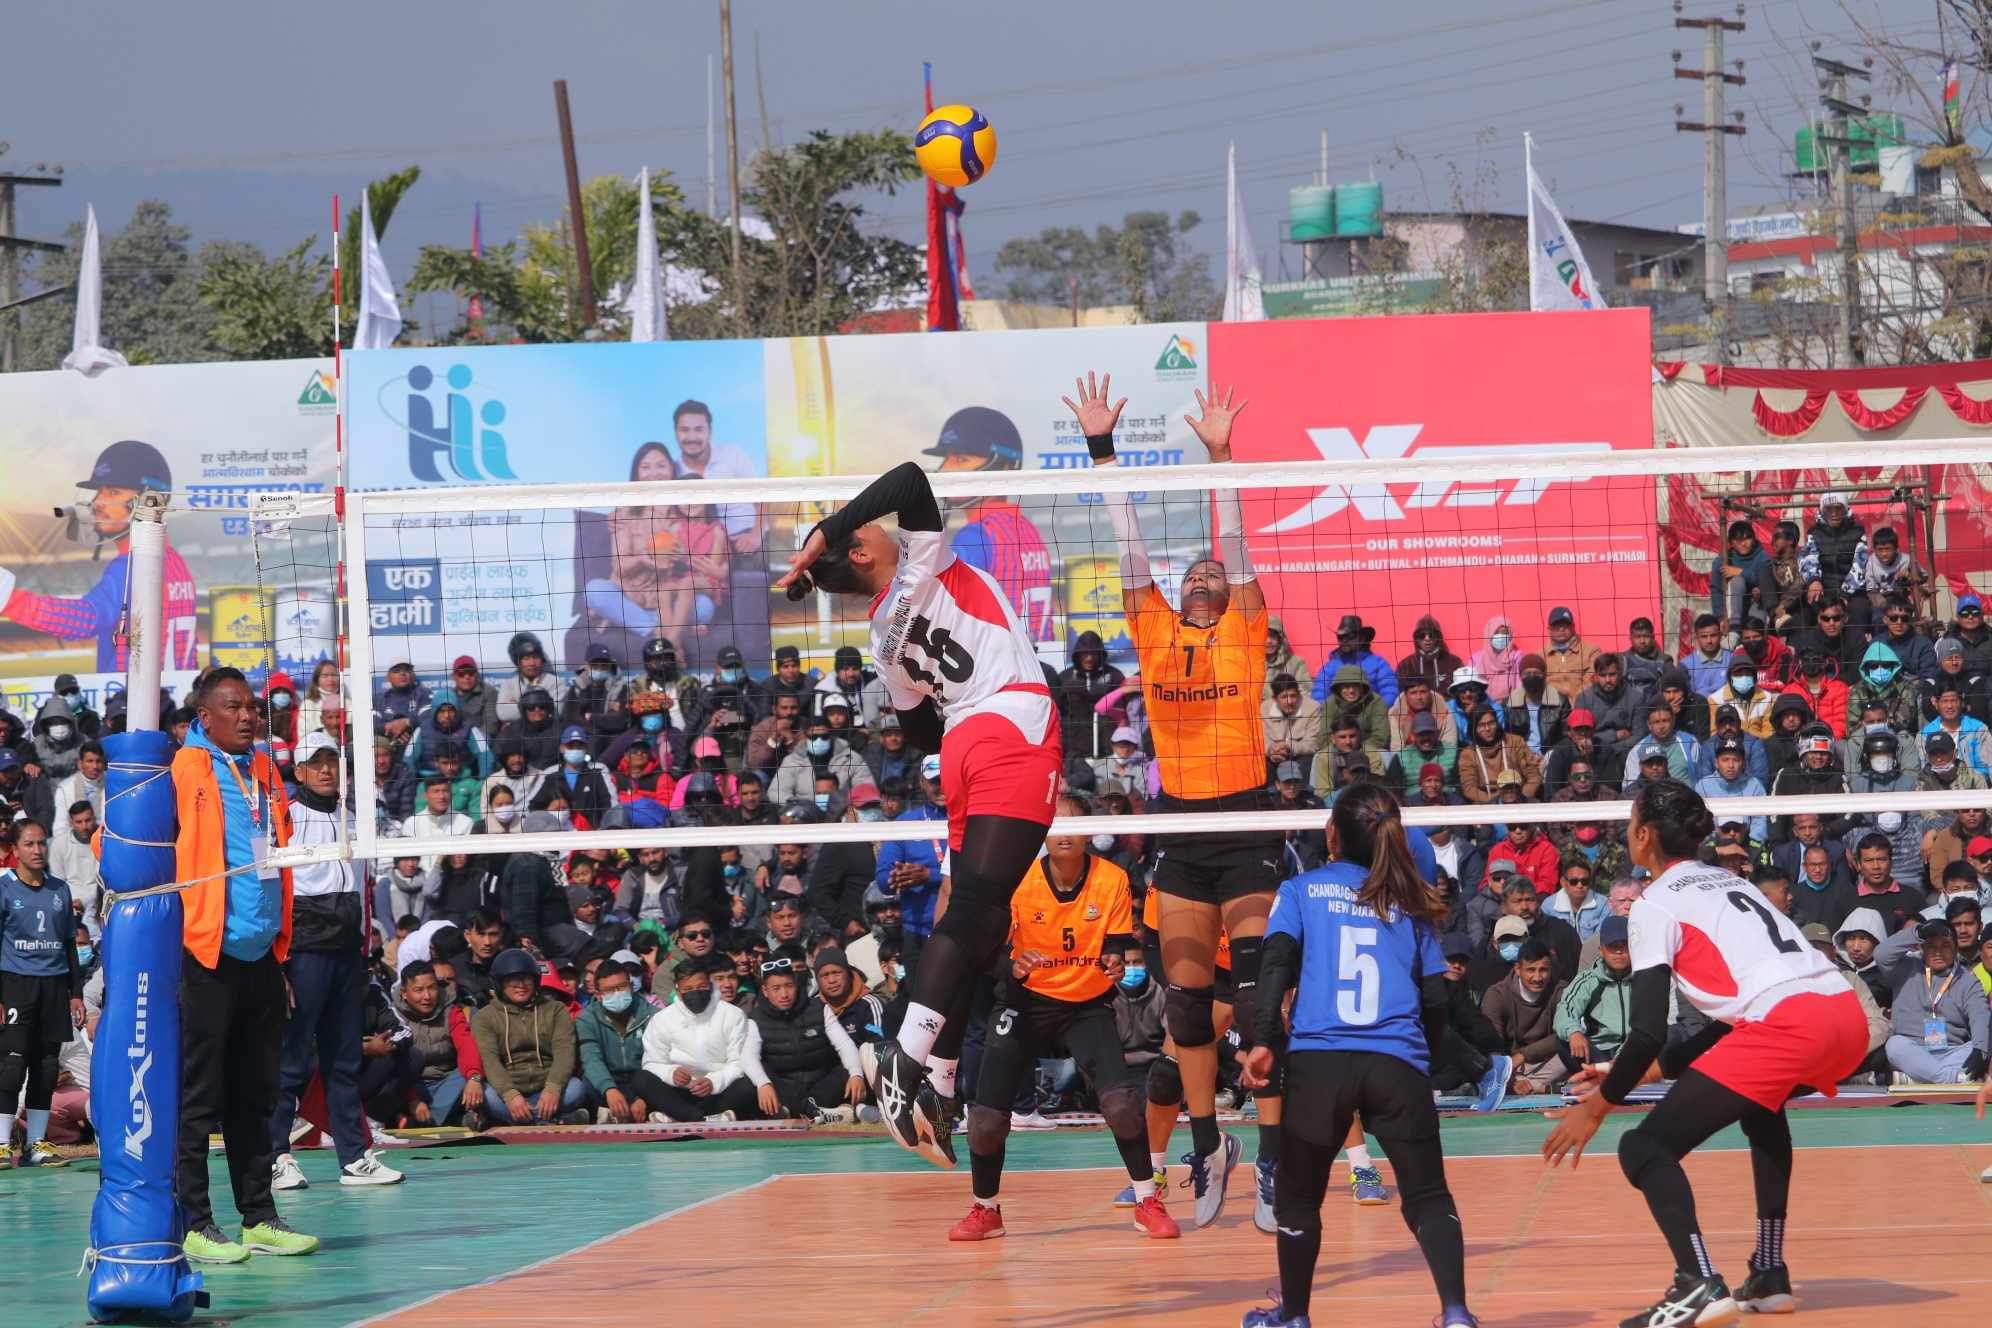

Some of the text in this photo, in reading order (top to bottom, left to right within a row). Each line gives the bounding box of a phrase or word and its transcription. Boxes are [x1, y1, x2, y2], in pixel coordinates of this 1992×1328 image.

[1366, 533, 1502, 552] OUR SHOWROOMS
[1368, 557, 1411, 570] BUTWAL
[1421, 553, 1486, 568] KATHMANDU
[1495, 554, 1539, 565] DHARAN
[1547, 551, 1596, 563] SURKHET
[384, 566, 433, 591] एक
[370, 595, 434, 629] हामी
[1152, 683, 1239, 702] Mahindra
[1328, 900, 1349, 913] NEW
[36, 910, 46, 933] 2
[1726, 890, 1804, 953] 2
[1062, 926, 1077, 953] 5
[1038, 954, 1102, 969] ahindra
[1337, 925, 1381, 1026] 5
[7, 1007, 19, 1025] 2
[995, 1008, 1019, 1036] 5
